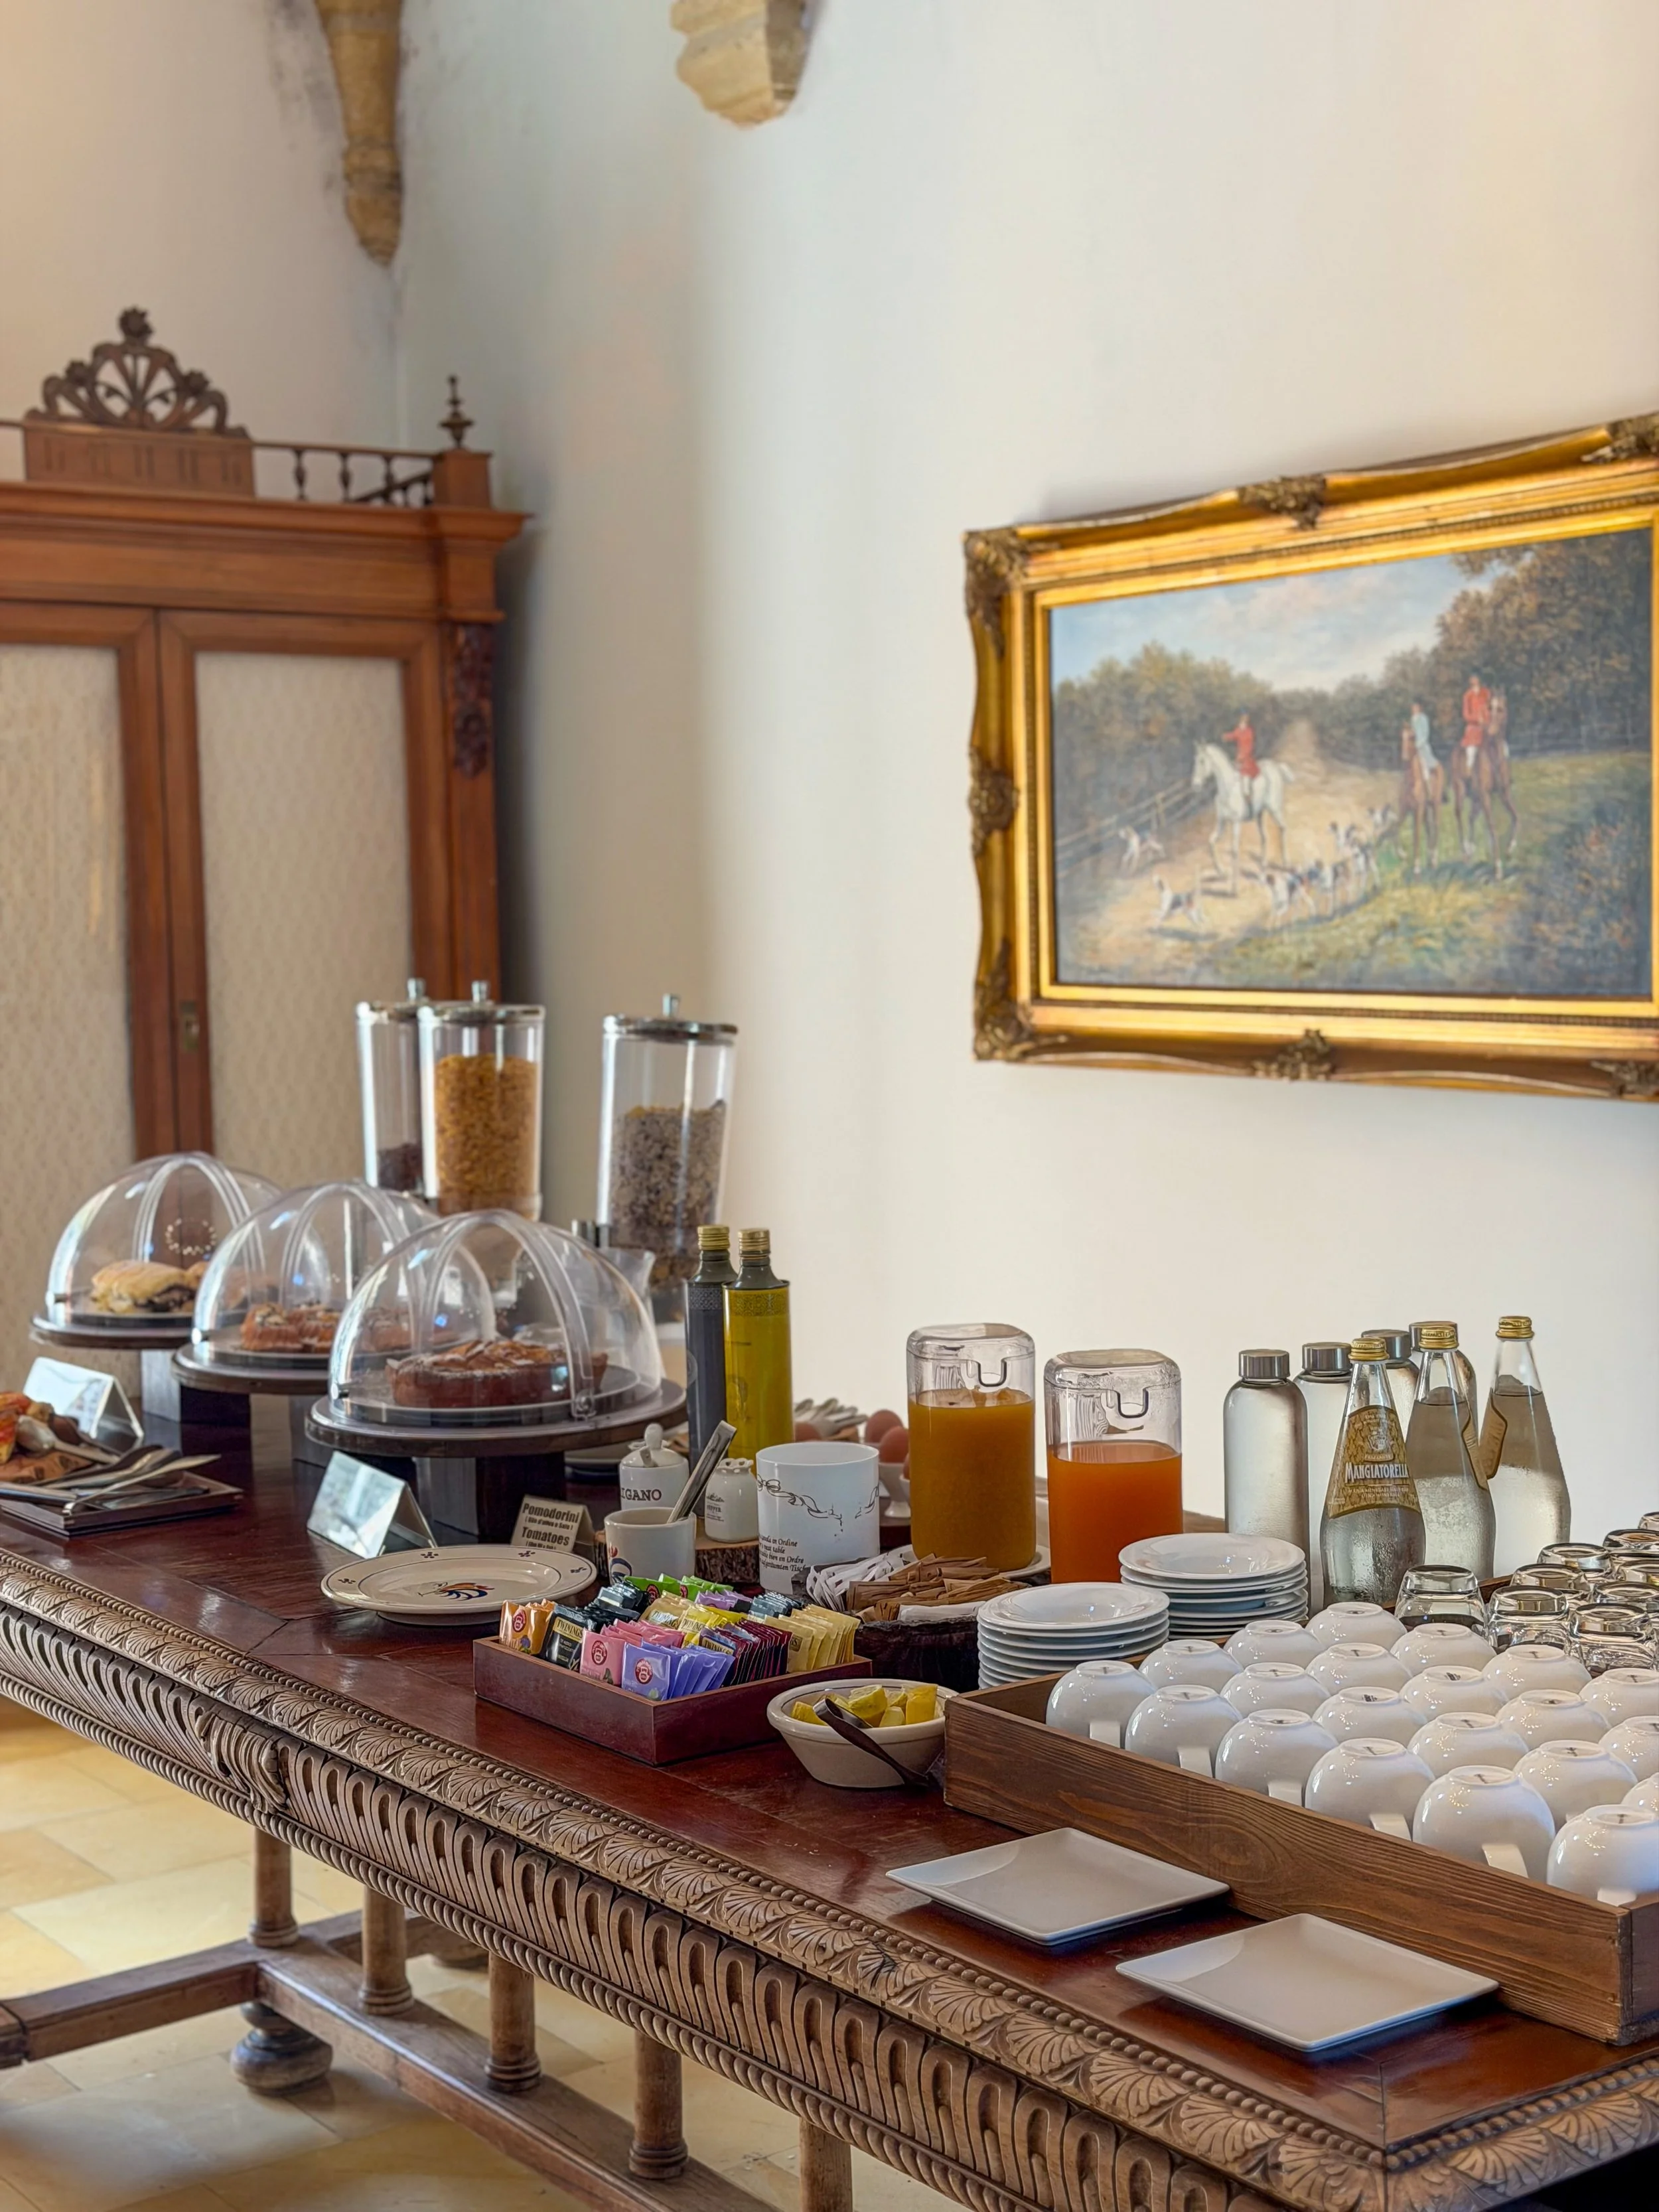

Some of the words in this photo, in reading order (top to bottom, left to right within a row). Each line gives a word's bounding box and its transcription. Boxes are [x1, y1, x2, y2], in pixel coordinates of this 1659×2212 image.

[1344, 1462, 1409, 1483] MANGIATORELLA
[522, 1503, 579, 1524] Pomodorini
[522, 1526, 570, 1546] Tomatoes
[778, 1538, 798, 1547] Ordine
[772, 1545, 785, 1554] table
[557, 1618, 583, 1638] TWININGS
